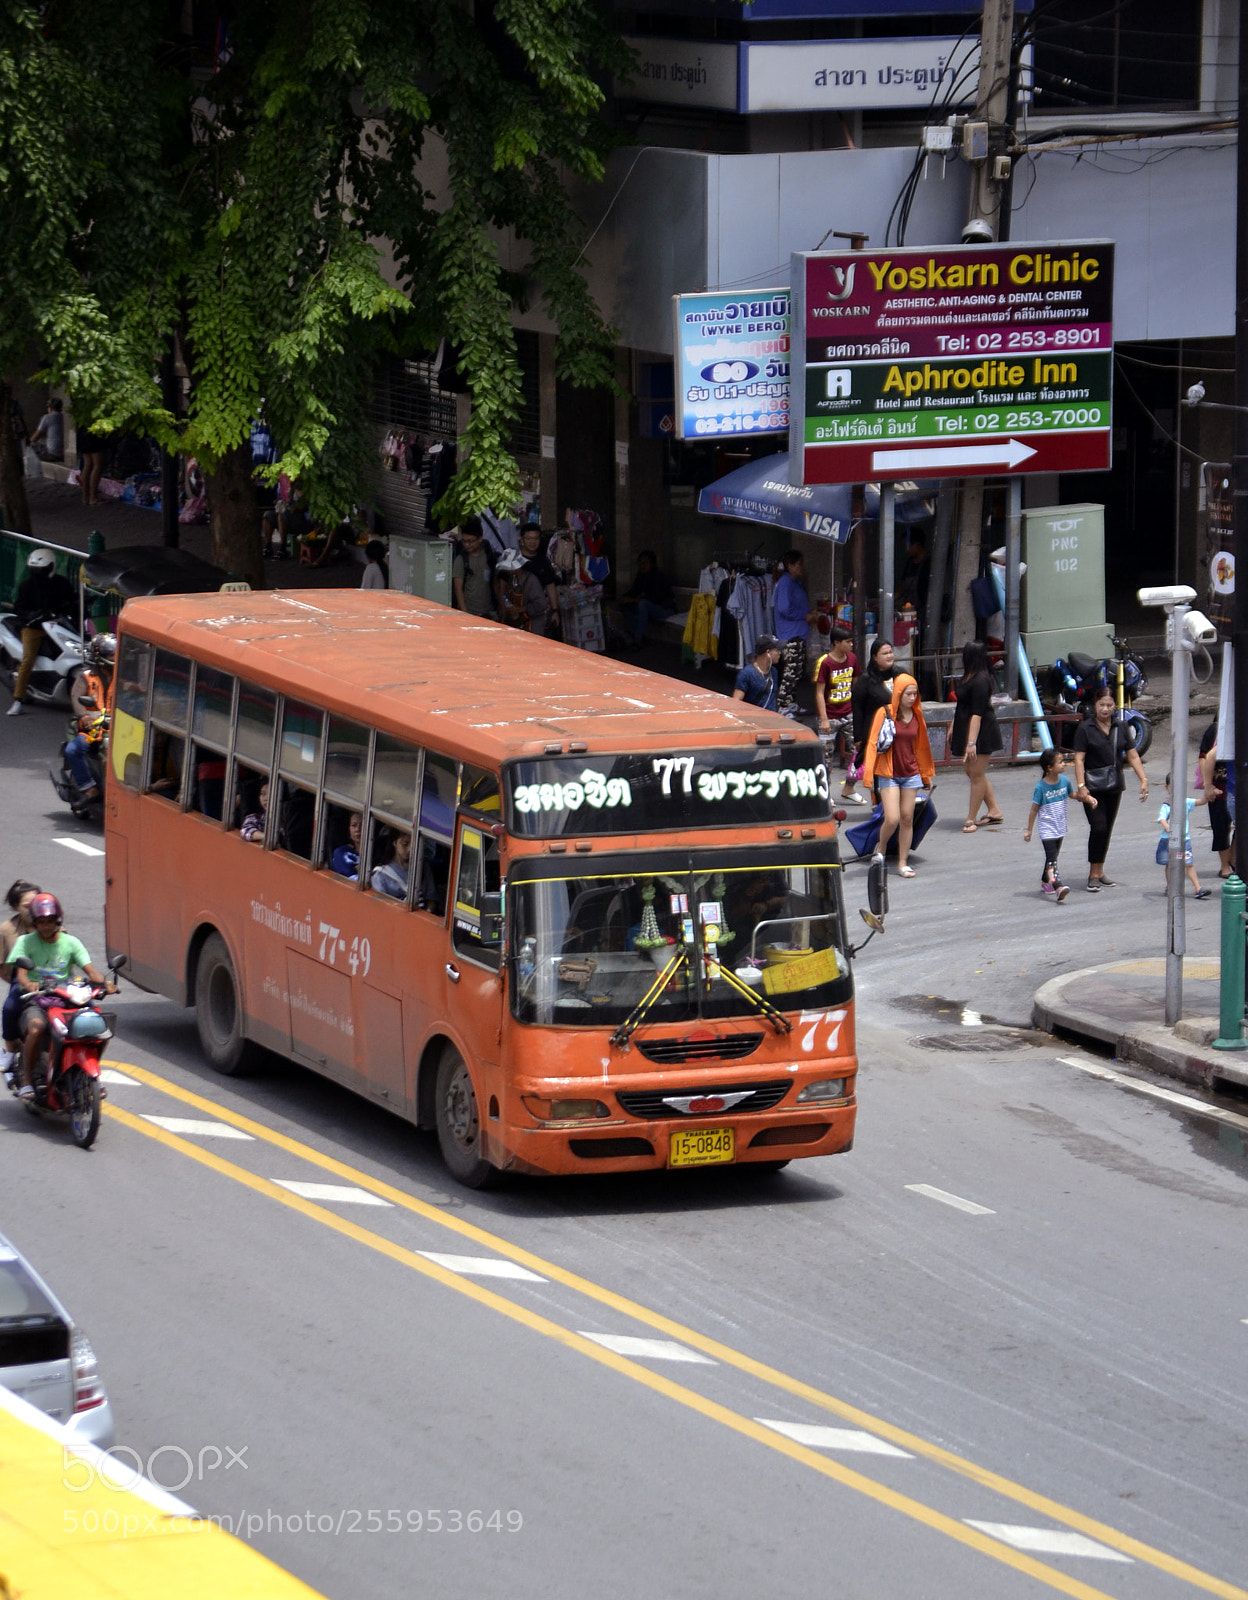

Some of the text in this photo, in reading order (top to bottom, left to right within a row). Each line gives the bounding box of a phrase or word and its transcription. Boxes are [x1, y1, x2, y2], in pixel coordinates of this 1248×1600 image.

[643, 57, 707, 89] สาขา ประตูน้ำ
[813, 56, 956, 91] สาขา ประตูน้ำ
[868, 252, 1100, 291] Yoskarn Clinic
[812, 305, 871, 318] YOSKARN
[885, 290, 1082, 310] AESTHETIC, ANTI-AGING & DENTAL CENTER
[701, 321, 787, 337] (WYNE BERG)
[938, 328, 1100, 352] Tel: 02 253-8901
[827, 338, 911, 358] ยศการคลีนิค
[883, 358, 1077, 396] Aphrodite Inn
[687, 387, 709, 401] รับ
[876, 394, 975, 409] Hotel and Restaurant
[977, 386, 1090, 404] โรงแรม และ ห้องอาหาร
[816, 415, 917, 439] อะโฟร์ดิเต้ อินน์
[935, 408, 1101, 432] Tel: 02 253-7000
[711, 492, 782, 516] RATCHAPRASONG
[803, 512, 841, 540] VISA
[1046, 517, 1084, 532] TOT
[1051, 536, 1079, 551] PNC
[1054, 558, 1078, 572] 102
[653, 756, 695, 795] 77
[514, 768, 632, 813] หมอชิต
[319, 920, 371, 977] 77-49
[799, 1009, 848, 1052] 77
[685, 1129, 720, 1137] THAILAND
[676, 1135, 731, 1156] 15-0848
